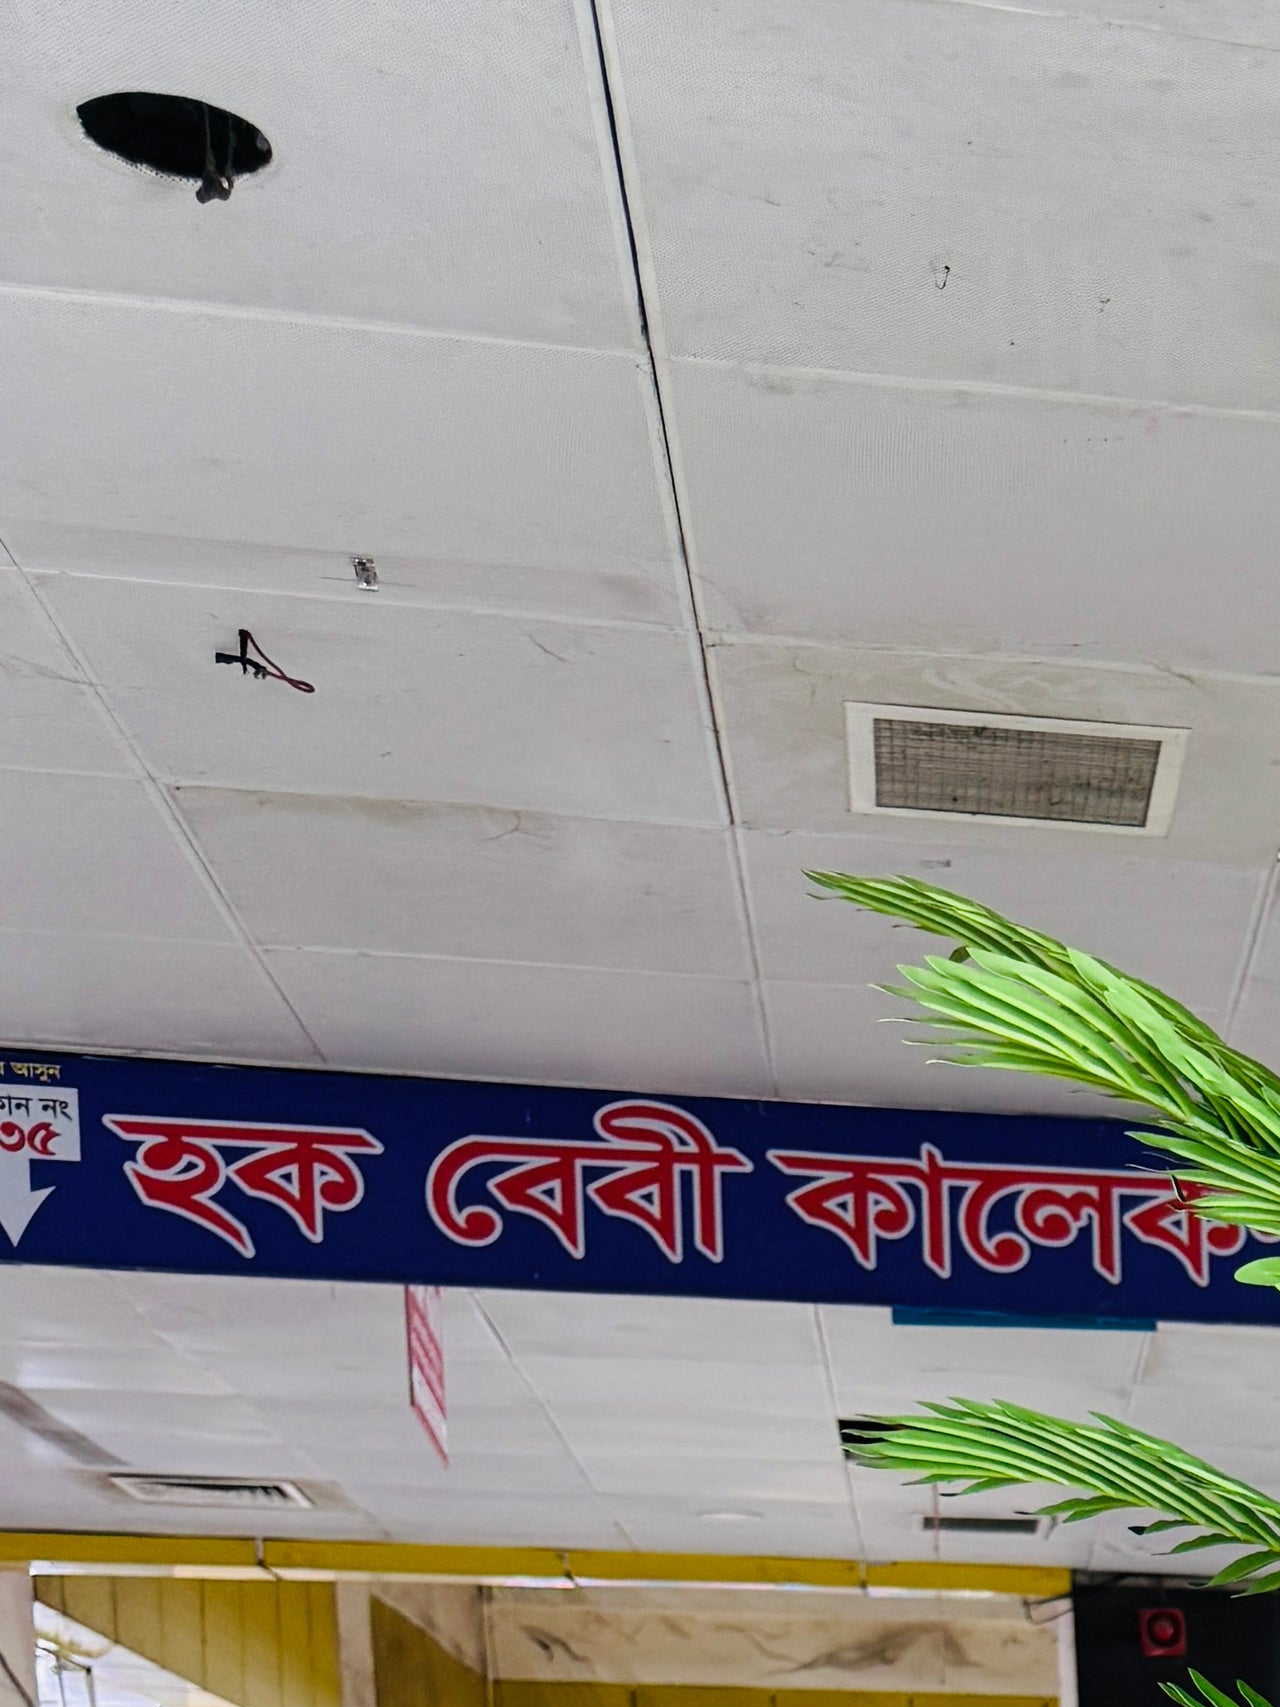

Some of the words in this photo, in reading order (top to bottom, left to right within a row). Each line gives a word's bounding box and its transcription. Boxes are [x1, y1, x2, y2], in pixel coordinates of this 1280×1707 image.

[38, 1098, 72, 1121] নং
[101, 1114, 384, 1258] হক
[426, 1100, 754, 1263] বেবী
